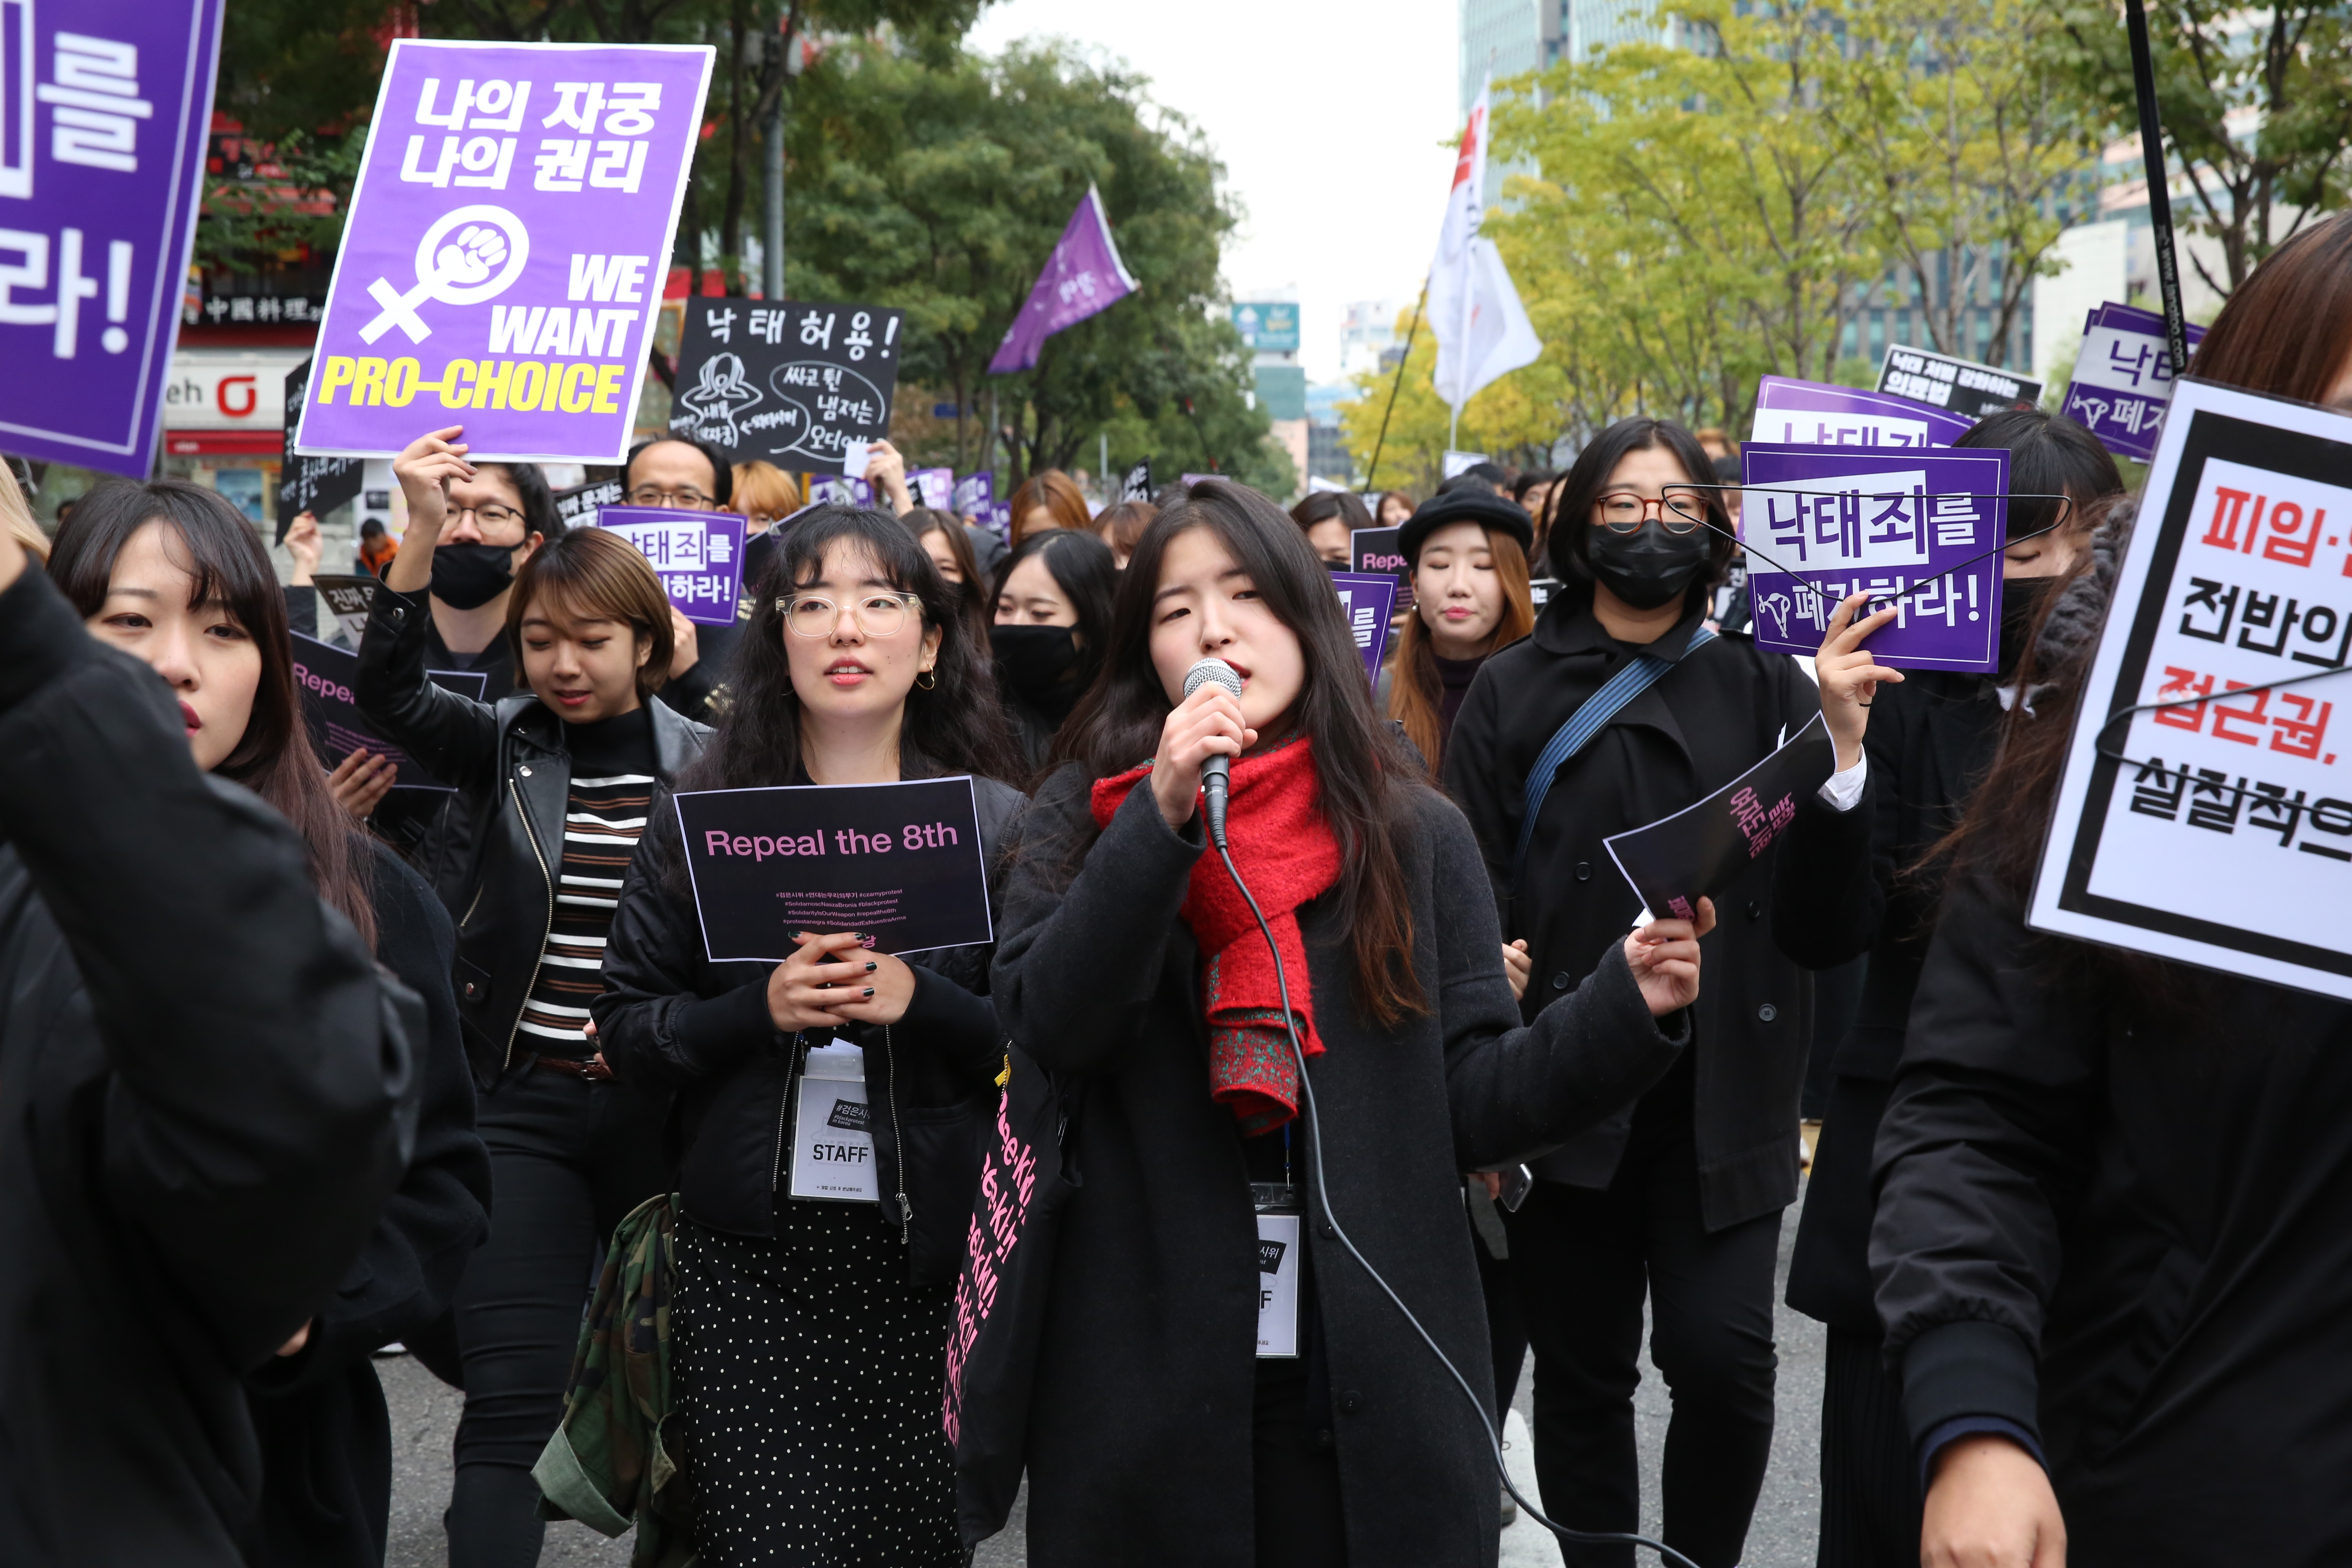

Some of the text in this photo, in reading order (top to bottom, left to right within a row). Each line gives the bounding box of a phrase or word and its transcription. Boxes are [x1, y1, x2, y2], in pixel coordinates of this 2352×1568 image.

[4, 0, 154, 172] 를
[415, 78, 662, 136] 나의 자궁
[400, 135, 649, 193] 나의 권리
[568, 254, 649, 303] WE
[488, 305, 639, 357] WANT
[317, 356, 626, 414] PRO-CHOICE
[782, 366, 820, 387] 싸고
[1767, 485, 1980, 561] 낙태죄를
[630, 530, 733, 565] 태죄를
[665, 574, 731, 604] 하라!
[2179, 576, 2352, 668] 전반의
[705, 822, 958, 862] Repeal the 8th
[859, 889, 902, 898] #czarnyprotest
[859, 898, 898, 907] #blackprotest
[827, 915, 906, 927] #SolidaridadEsNuestraArma
[857, 908, 896, 917] #repealthe8th
[834, 1115, 865, 1125] #blackprotest
[836, 1104, 870, 1119] #검은시
[813, 1144, 869, 1163] STAFF
